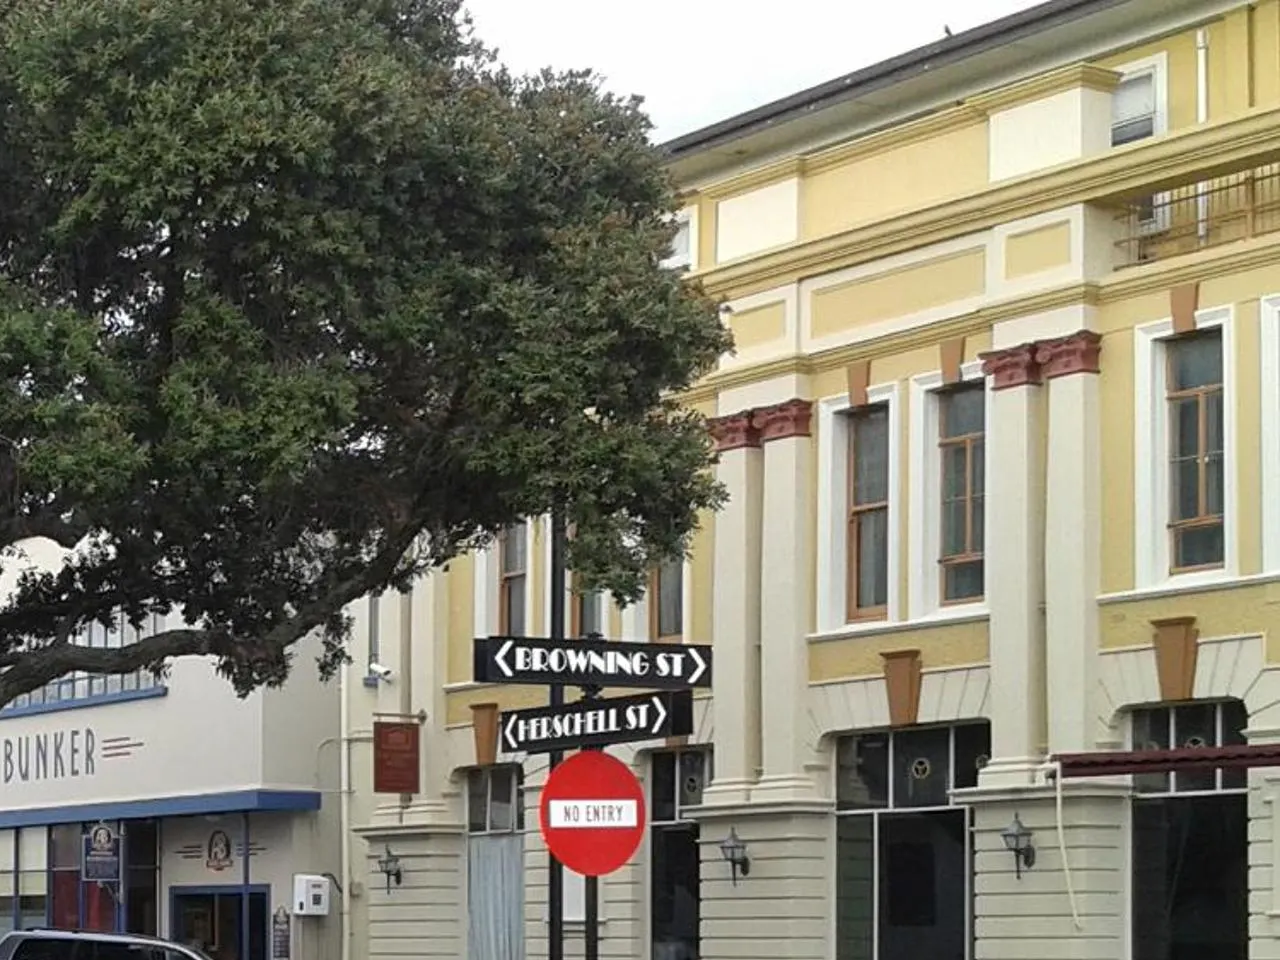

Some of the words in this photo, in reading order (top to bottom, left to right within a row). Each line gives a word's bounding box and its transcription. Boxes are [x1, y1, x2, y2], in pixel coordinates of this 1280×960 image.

[514, 647, 649, 676] BROWNING
[655, 652, 686, 678] ST
[518, 707, 621, 742] HERSCHELL
[625, 704, 650, 730] ST
[3, 727, 96, 784] BUNKER
[563, 804, 580, 823] NO
[585, 804, 625, 823] ENTRY
